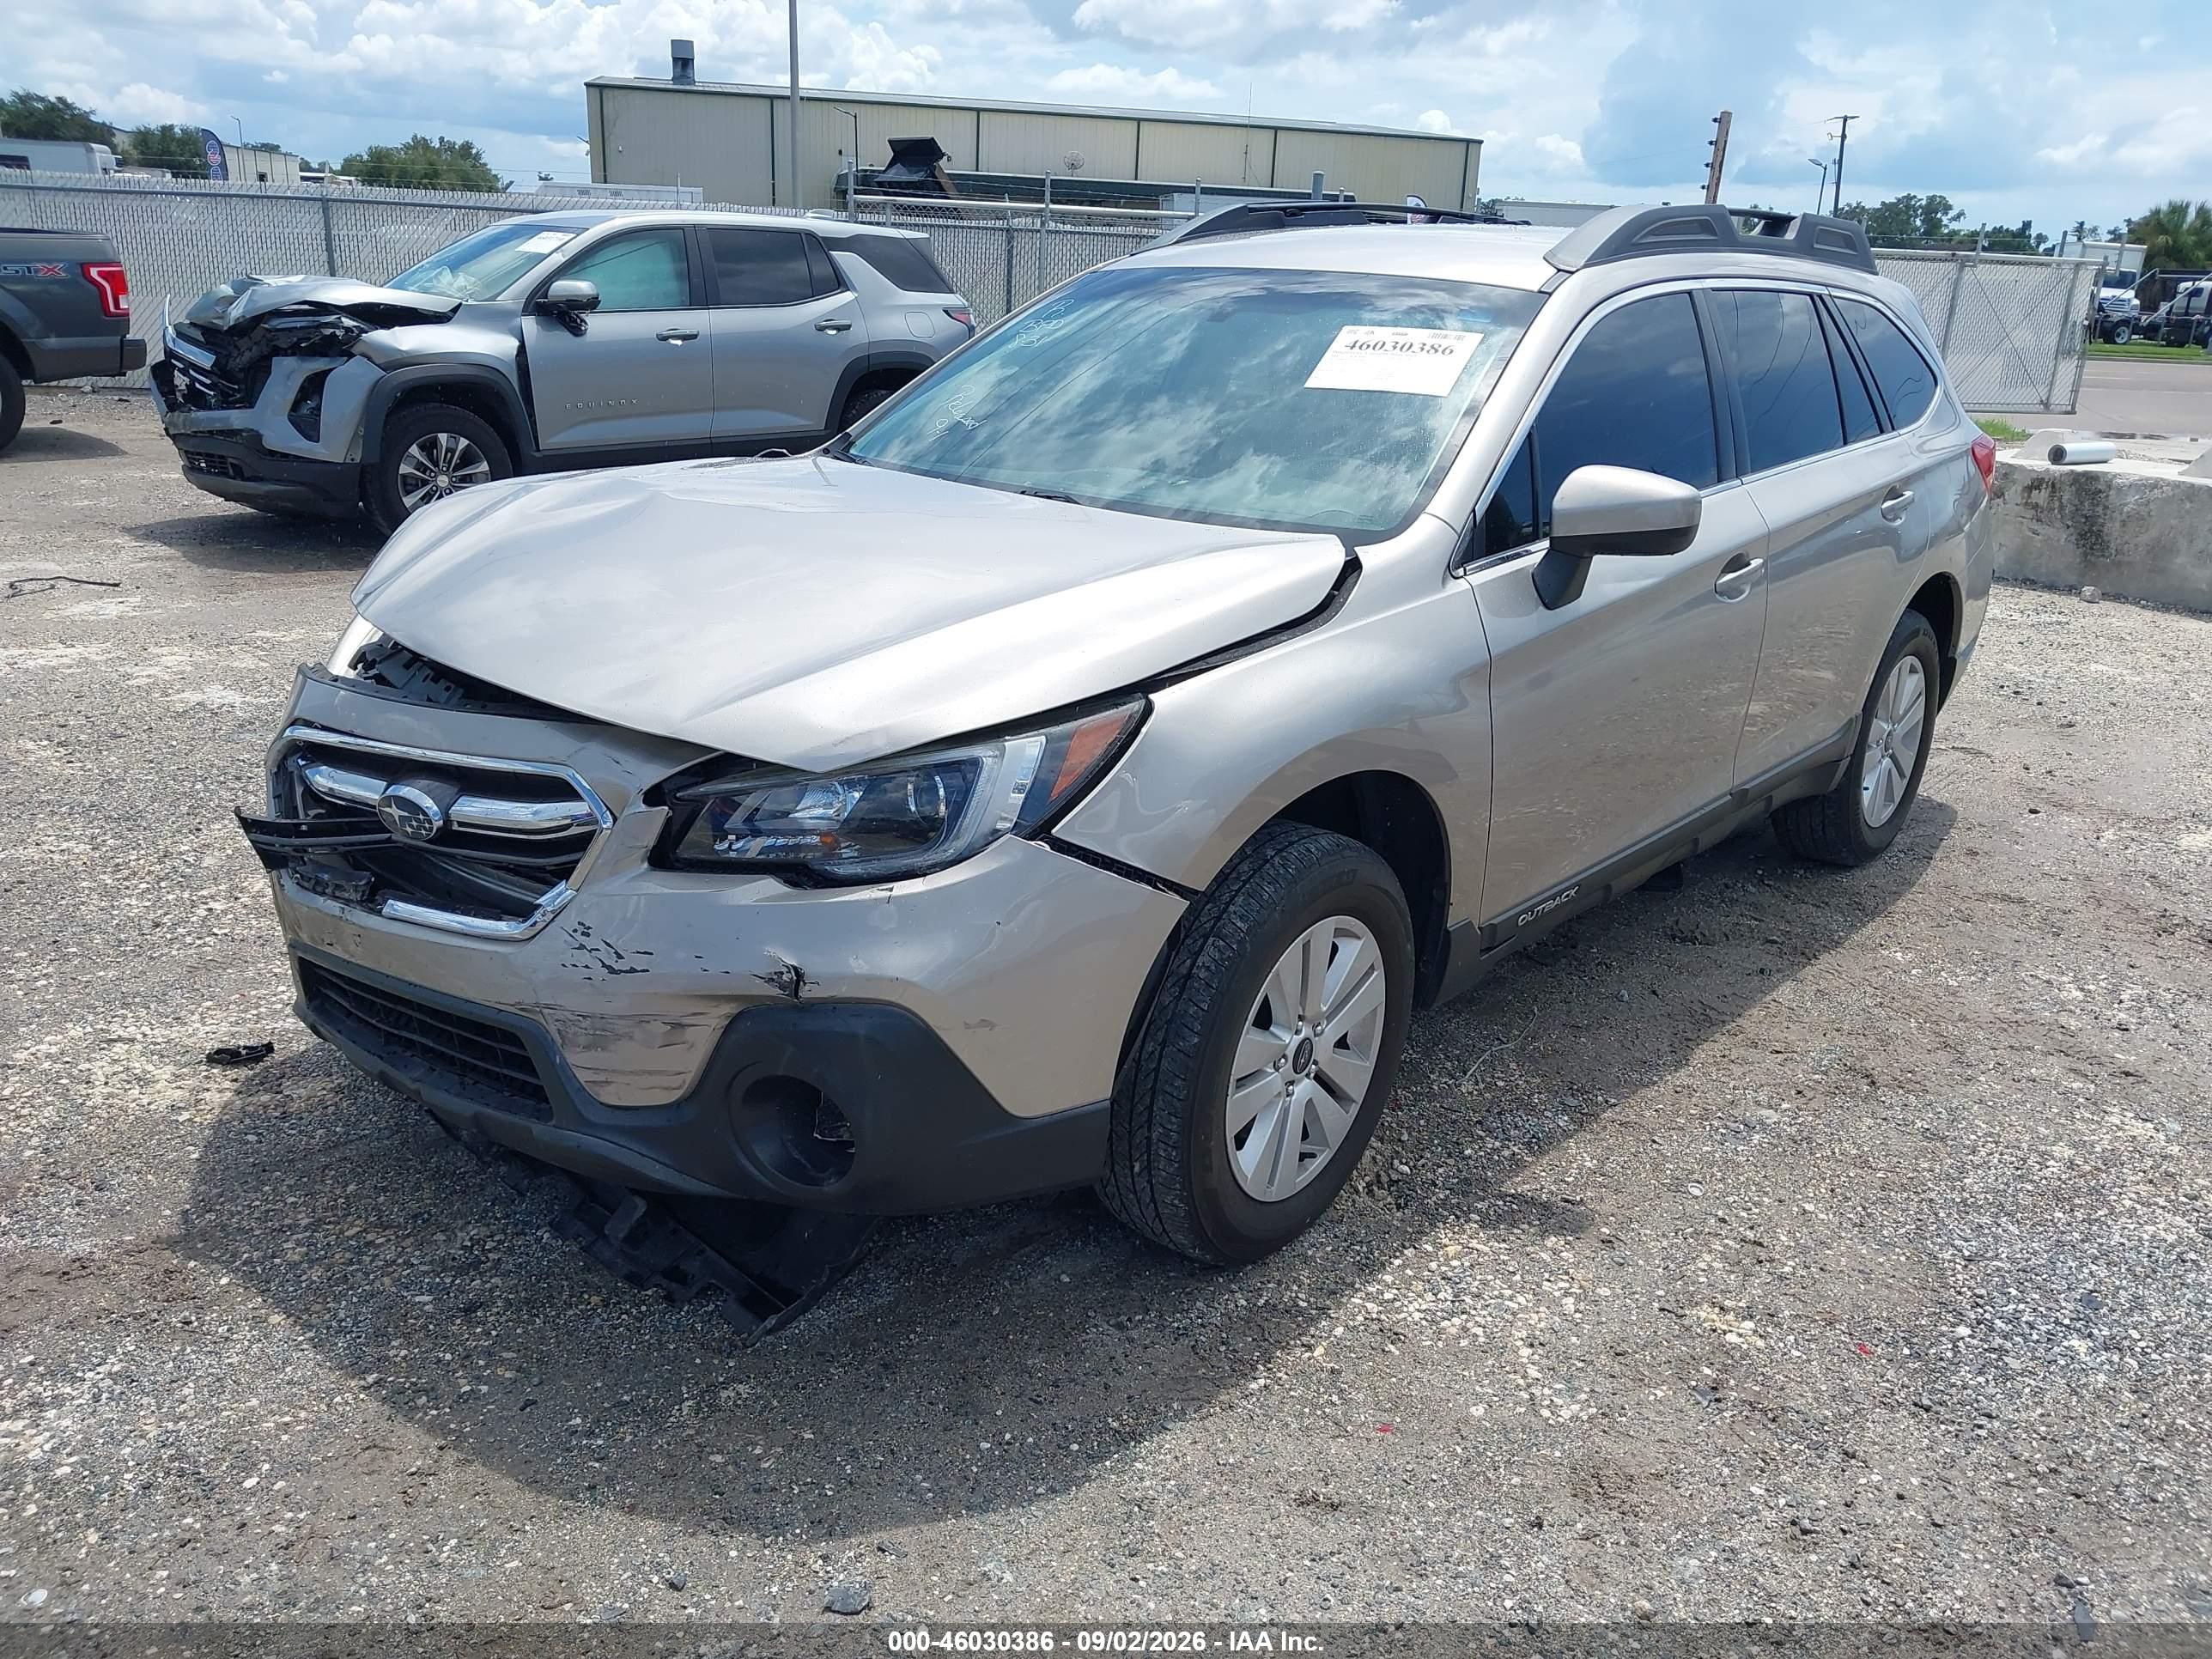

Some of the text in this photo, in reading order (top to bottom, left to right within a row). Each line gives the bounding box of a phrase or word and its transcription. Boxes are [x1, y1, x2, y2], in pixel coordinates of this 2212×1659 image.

[0, 263, 69, 278] STX
[1345, 339, 1455, 356] 46030386
[565, 398, 638, 410] EQUINOX
[1517, 885, 1580, 927] OUTBACK
